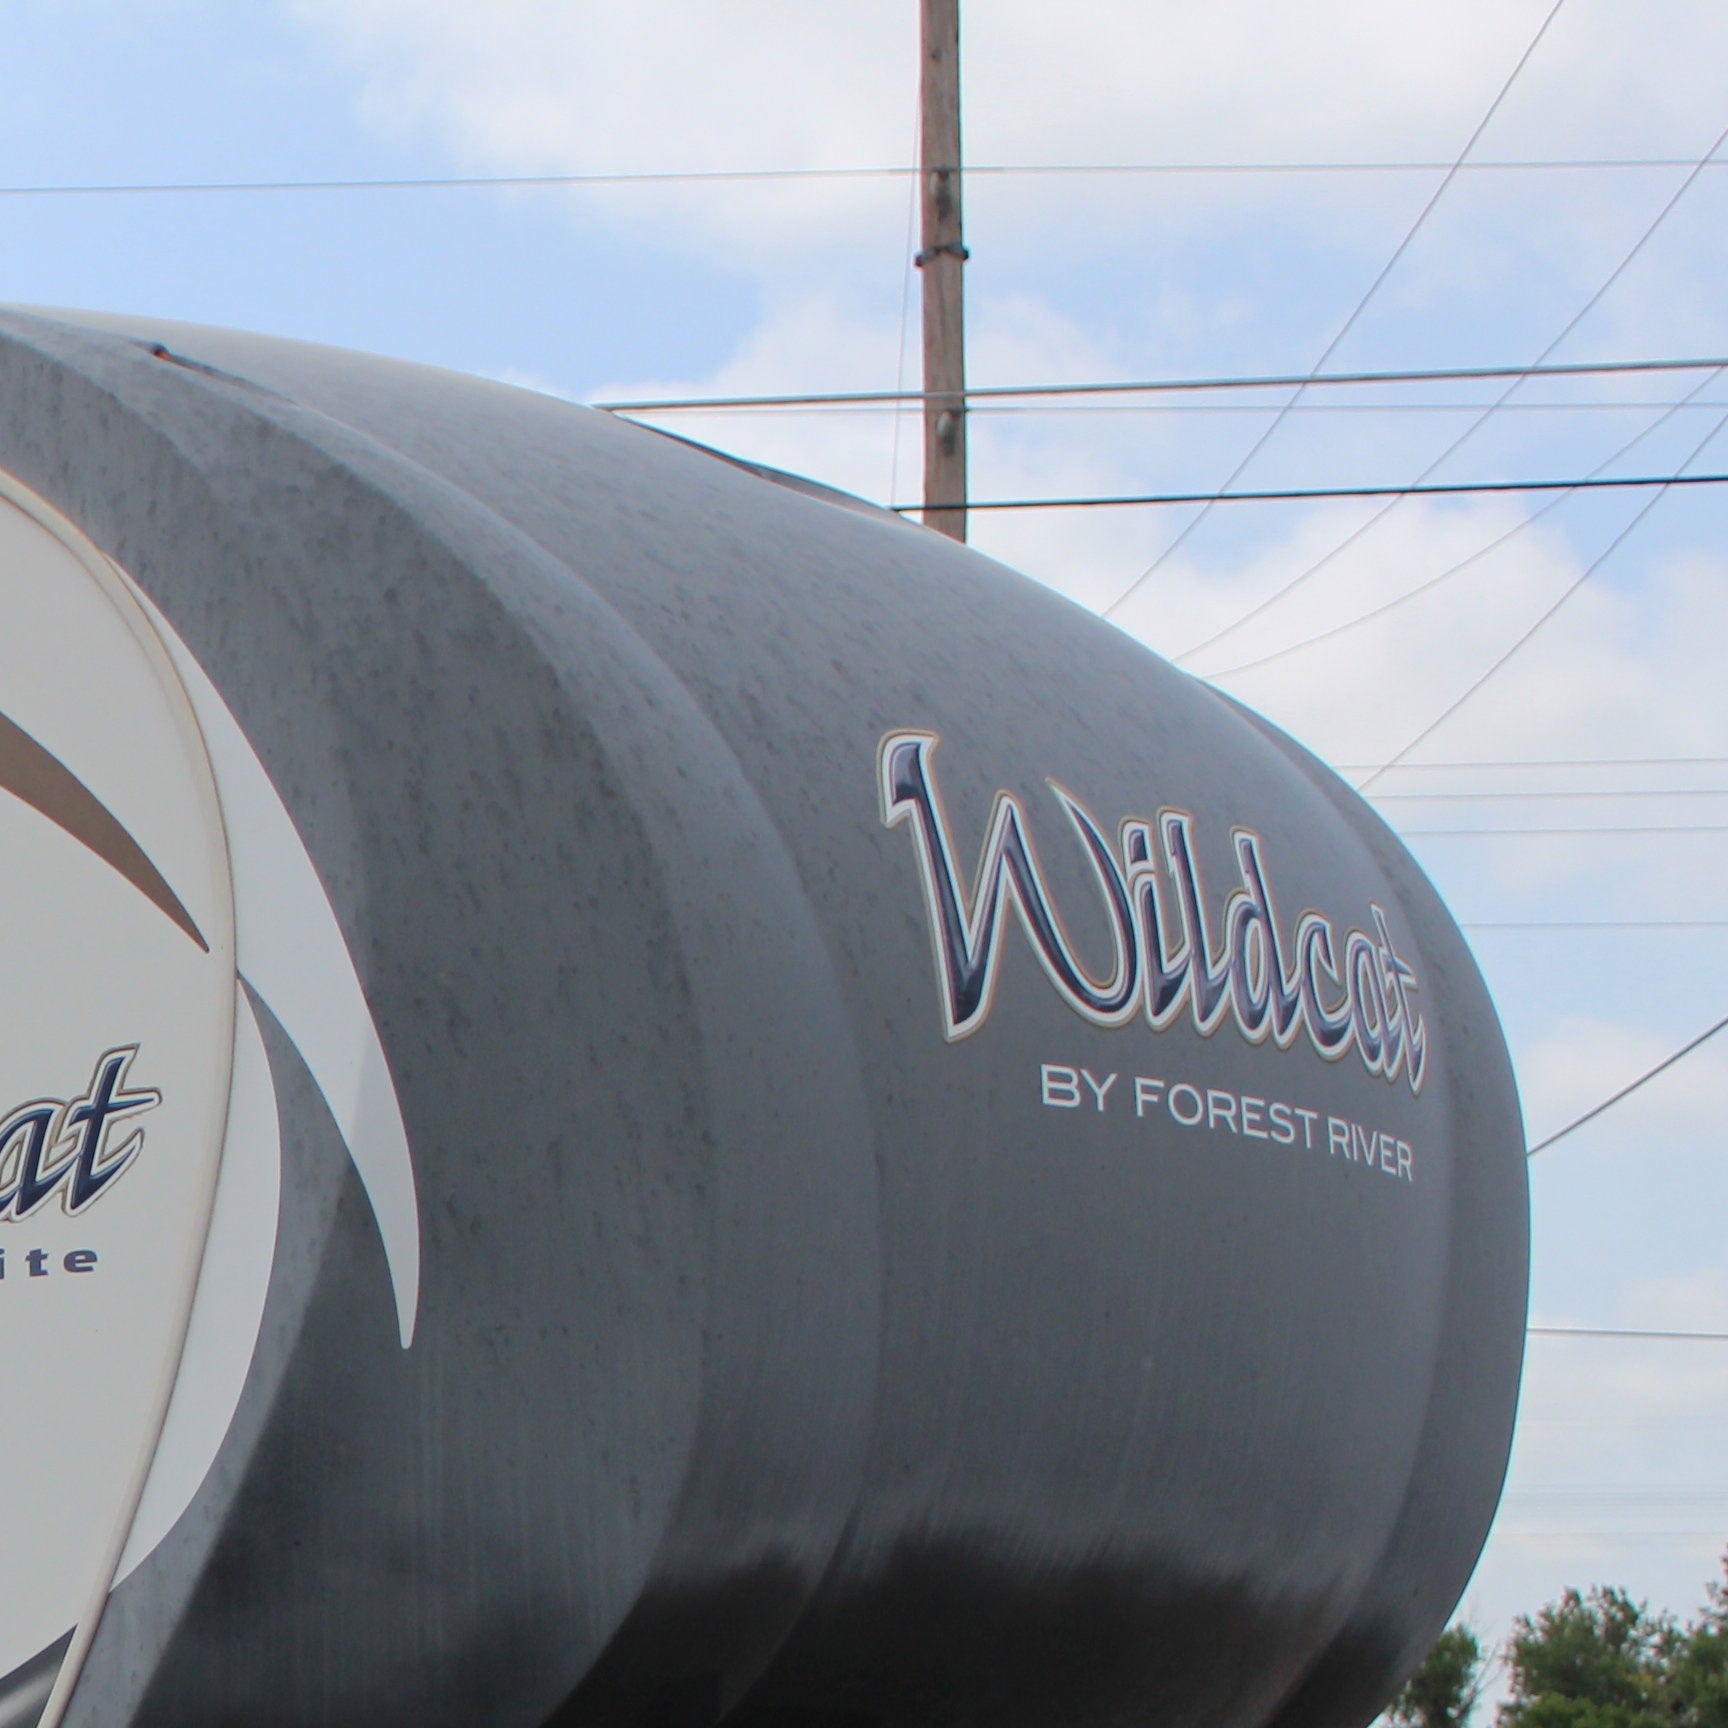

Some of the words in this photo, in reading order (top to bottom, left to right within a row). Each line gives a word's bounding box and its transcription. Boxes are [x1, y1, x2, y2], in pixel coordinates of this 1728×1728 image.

[878, 729, 1425, 1096] Wildcat
[1041, 1064, 1118, 1111] BY
[1134, 1077, 1318, 1149] FOREST
[1328, 1116, 1412, 1182] RIVER
